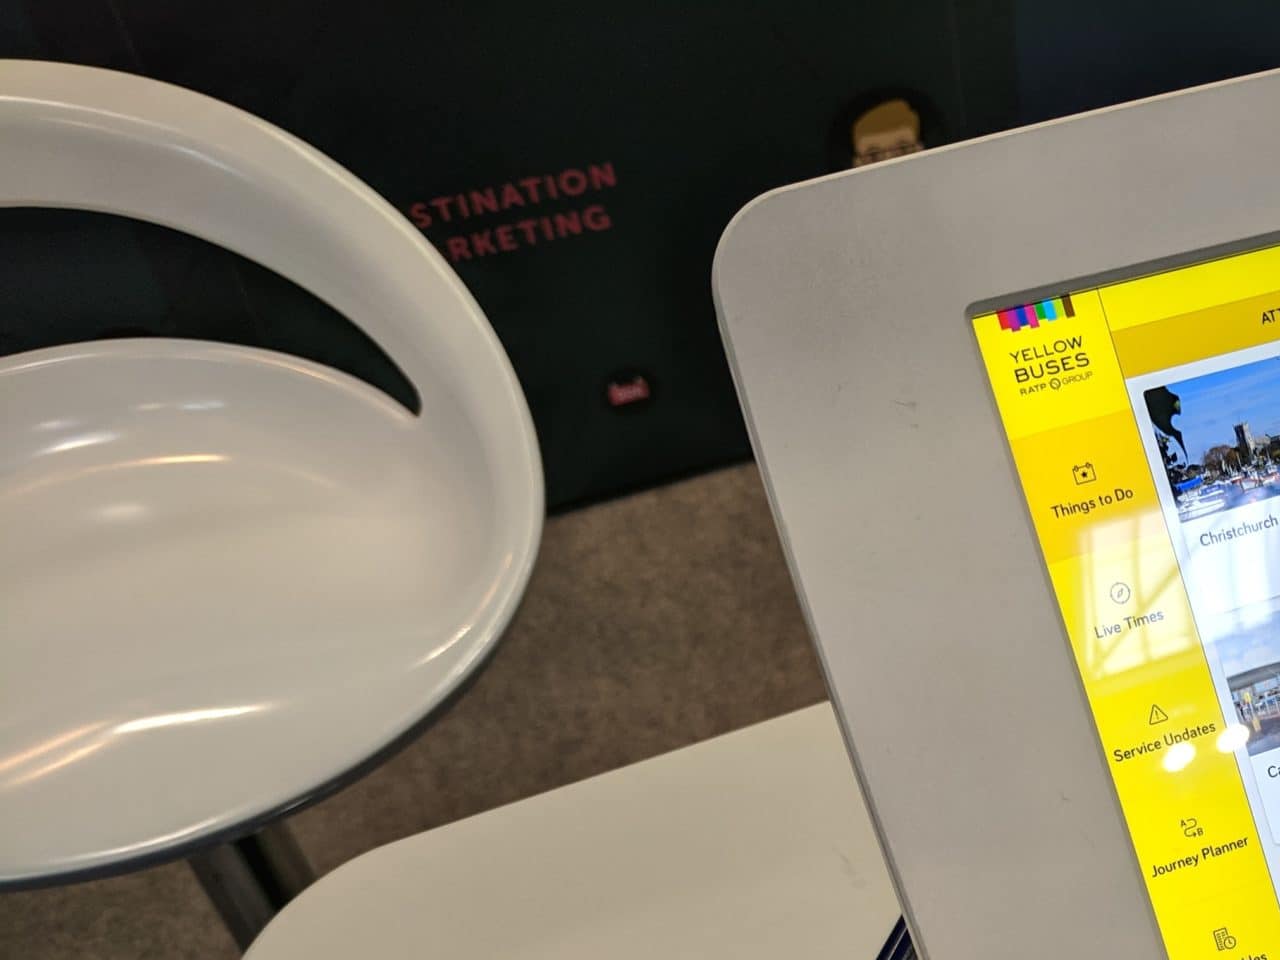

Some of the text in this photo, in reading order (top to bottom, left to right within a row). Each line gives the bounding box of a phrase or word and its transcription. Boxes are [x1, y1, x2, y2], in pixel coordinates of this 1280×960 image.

[408, 161, 617, 229] STINATION
[446, 204, 611, 262] RKETING
[1008, 335, 1083, 363] YELLOW
[1014, 352, 1089, 383] BUSES
[1019, 370, 1093, 396] RATP GROUP
[1050, 487, 1133, 520] Things to Do
[1198, 513, 1278, 547] Christchurch
[1093, 609, 1164, 639] Live Times
[1113, 720, 1216, 762] Service Updates
[1151, 835, 1249, 877] Journey Planner
